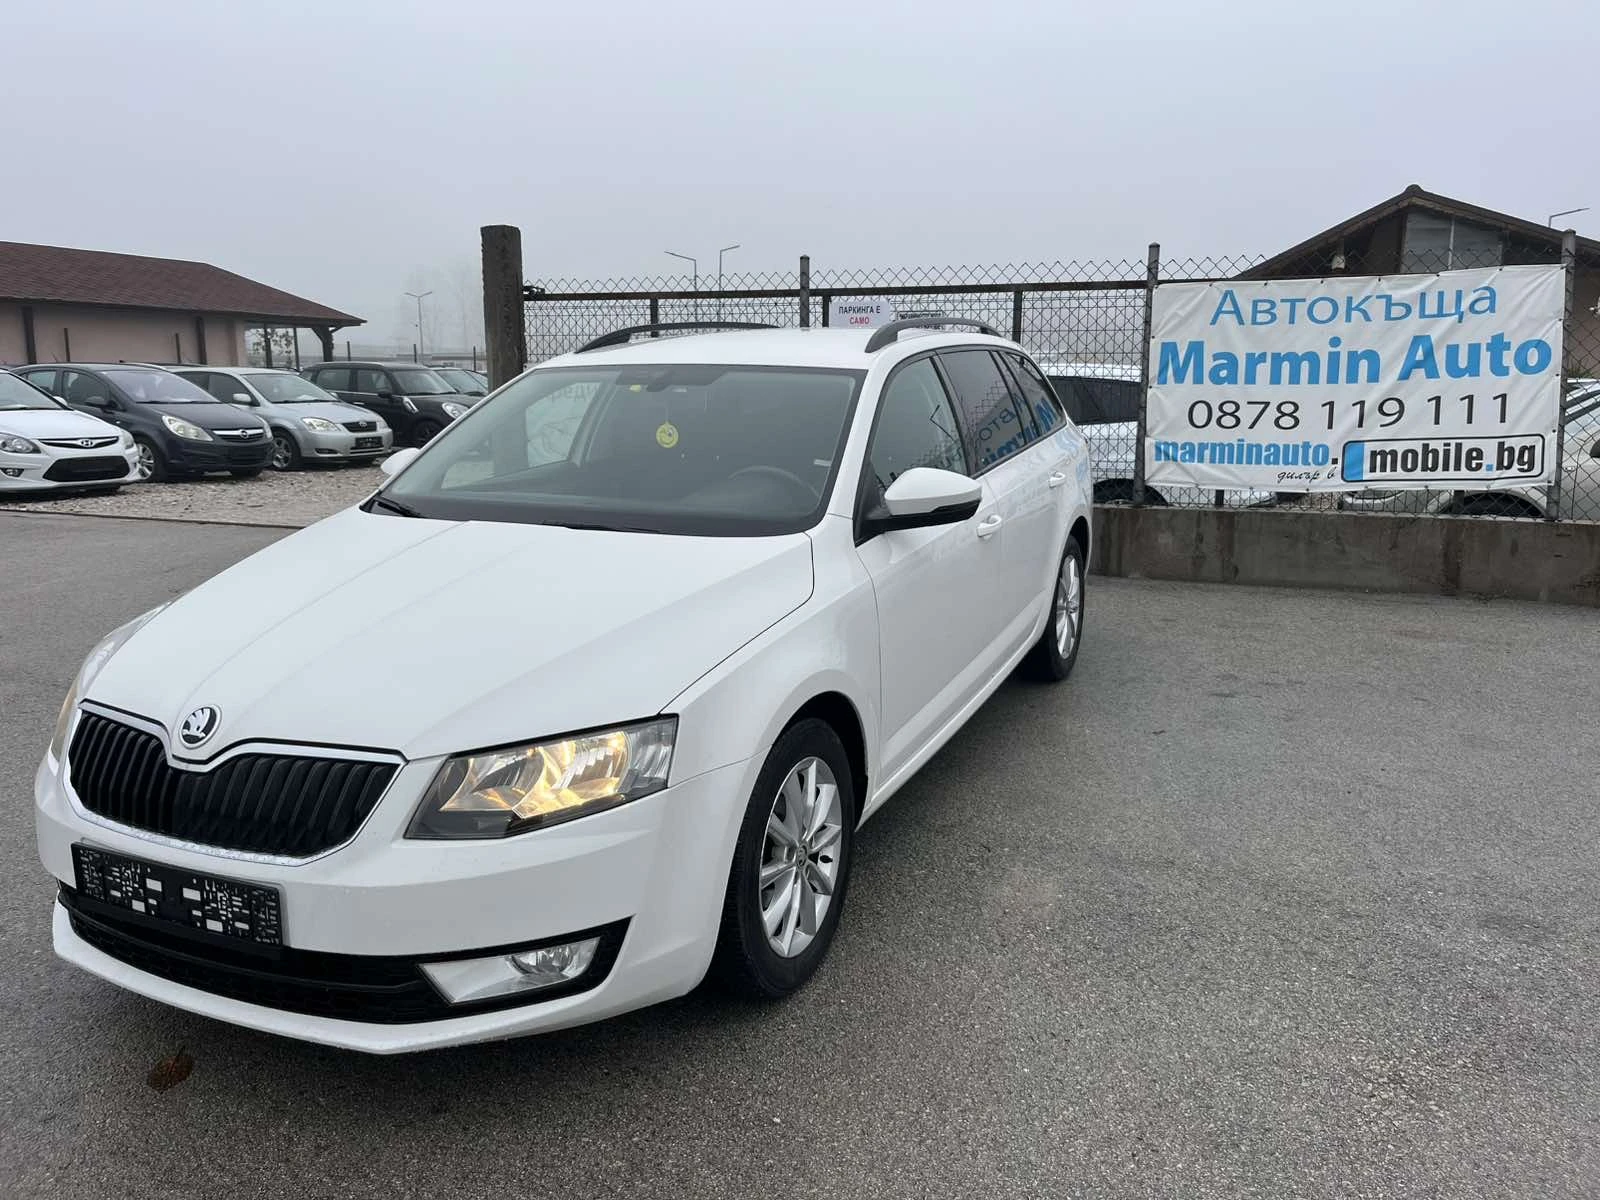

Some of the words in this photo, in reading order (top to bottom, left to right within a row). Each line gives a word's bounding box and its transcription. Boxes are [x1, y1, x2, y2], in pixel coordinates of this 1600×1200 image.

[838, 305, 874, 315] ПАРКИНГА
[876, 305, 881, 314] Е
[849, 316, 870, 325] САМО
[1210, 285, 1497, 327] Автокъща
[1157, 336, 1381, 386] Marmin
[1399, 332, 1553, 381] Auto
[1187, 399, 1301, 431] 0878
[1320, 398, 1407, 431] 119
[1426, 392, 1510, 426] 111
[1368, 441, 1537, 474] mobile.bg
